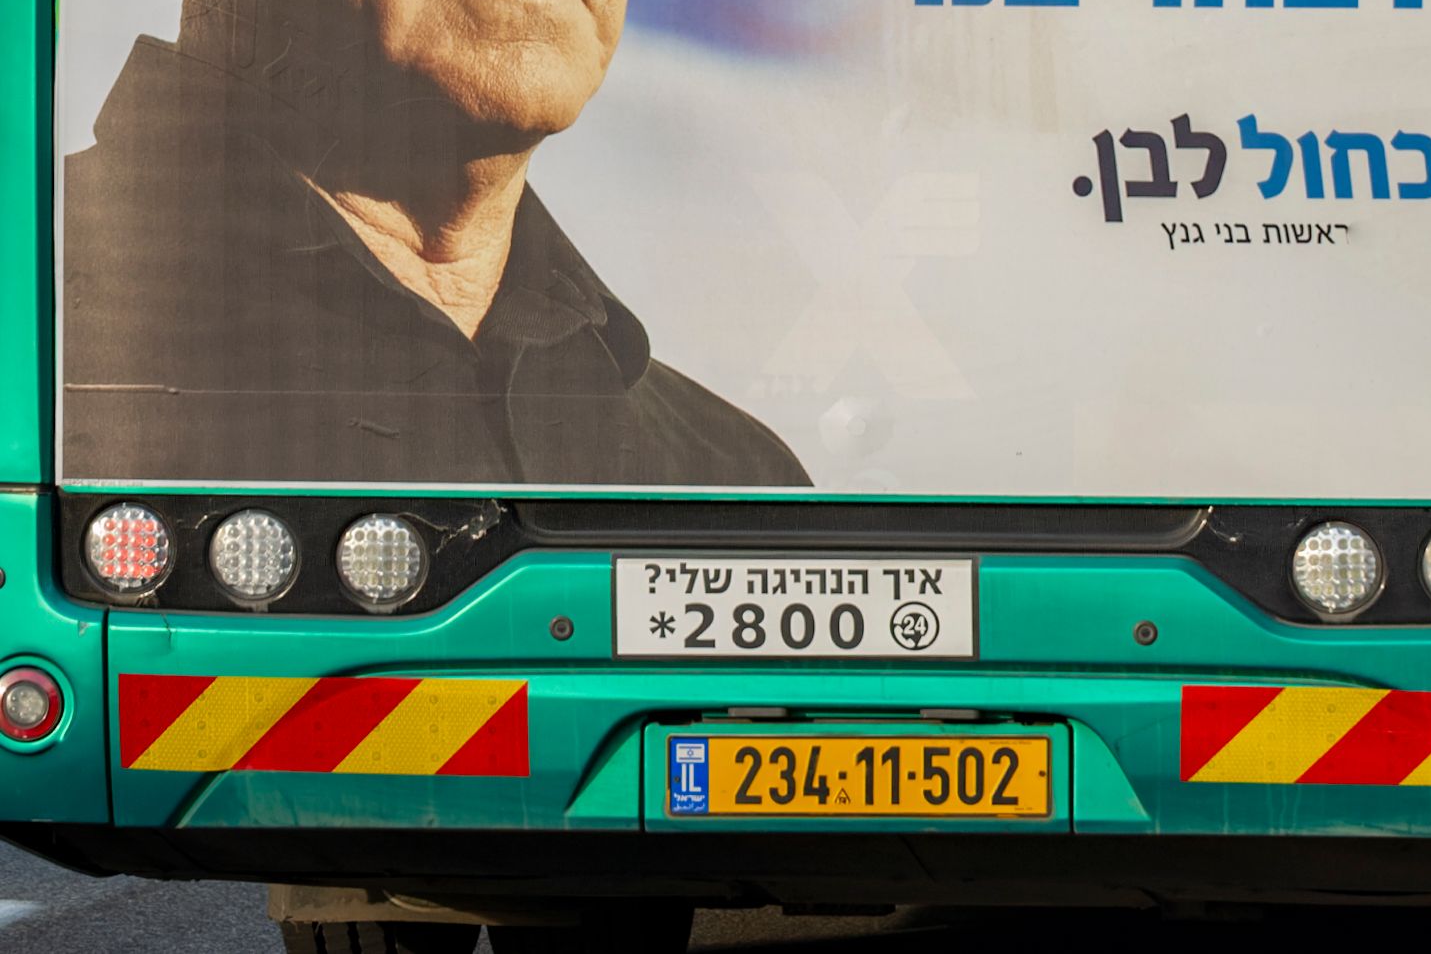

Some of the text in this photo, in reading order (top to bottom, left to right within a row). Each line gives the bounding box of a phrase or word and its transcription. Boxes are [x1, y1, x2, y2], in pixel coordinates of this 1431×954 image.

[1072, 112, 1227, 223] לבן.
[1161, 222, 1205, 250] גנץ
[1214, 222, 1251, 244] בני
[645, 563, 943, 600] איך הנהיגה שלי?
[903, 614, 927, 636] 24
[681, 763, 702, 792] IL
